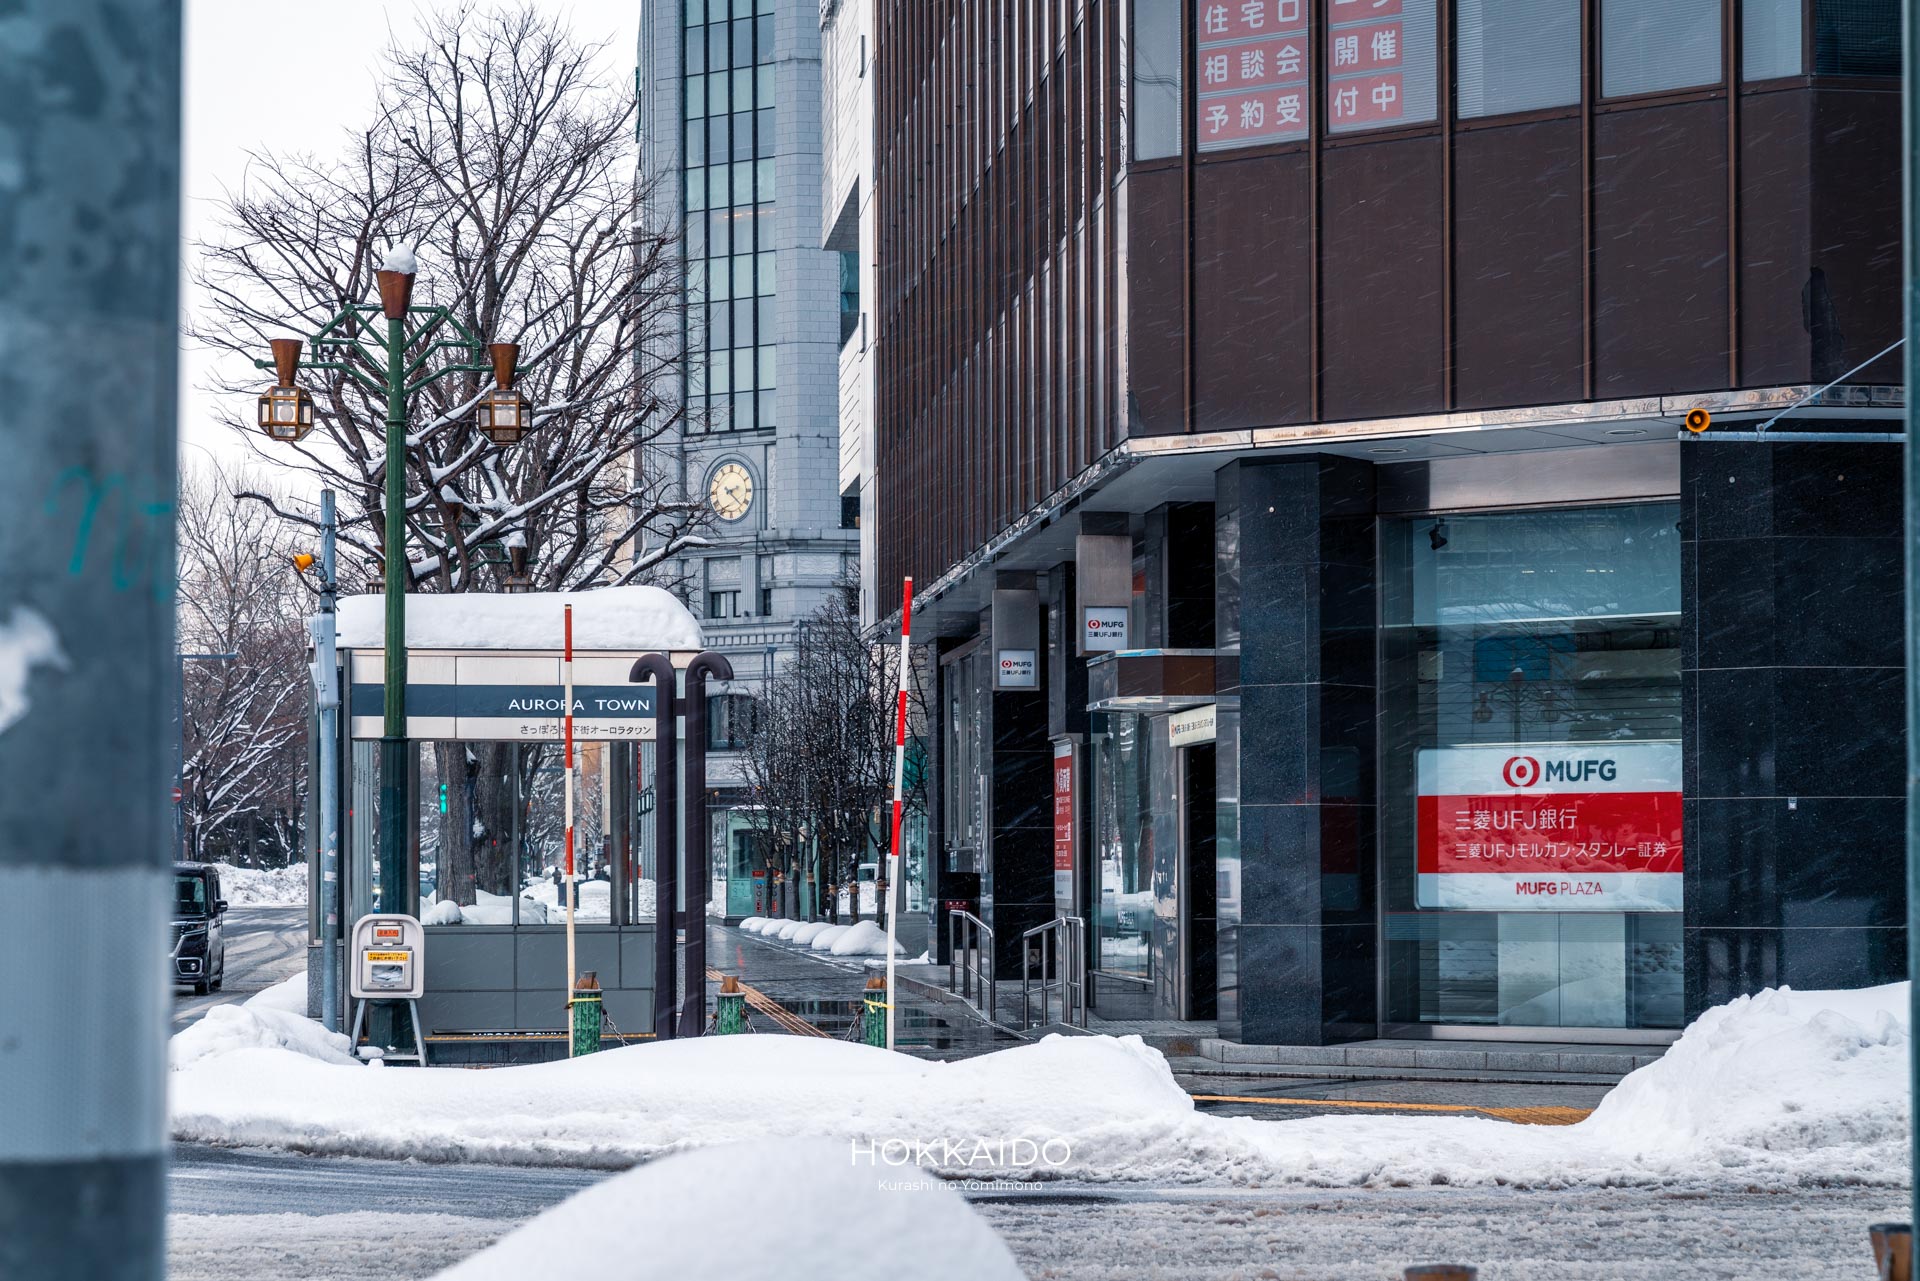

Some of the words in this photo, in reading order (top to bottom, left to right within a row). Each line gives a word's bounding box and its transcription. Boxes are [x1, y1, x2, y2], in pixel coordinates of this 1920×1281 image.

[1204, 44, 1301, 85] 相談会
[1334, 29, 1396, 67] 開催
[1204, 95, 1301, 134] 予約受
[1334, 82, 1397, 117] 付中
[595, 699, 650, 711] TOWN
[1545, 760, 1617, 782] MUFG
[1455, 808, 1577, 830] 三菱UFJ銀行
[1455, 842, 1668, 859] 三菱UFJモルガン・スタンレー証券
[1516, 882, 1557, 895] MUFG
[1561, 882, 1603, 895] PLAZA
